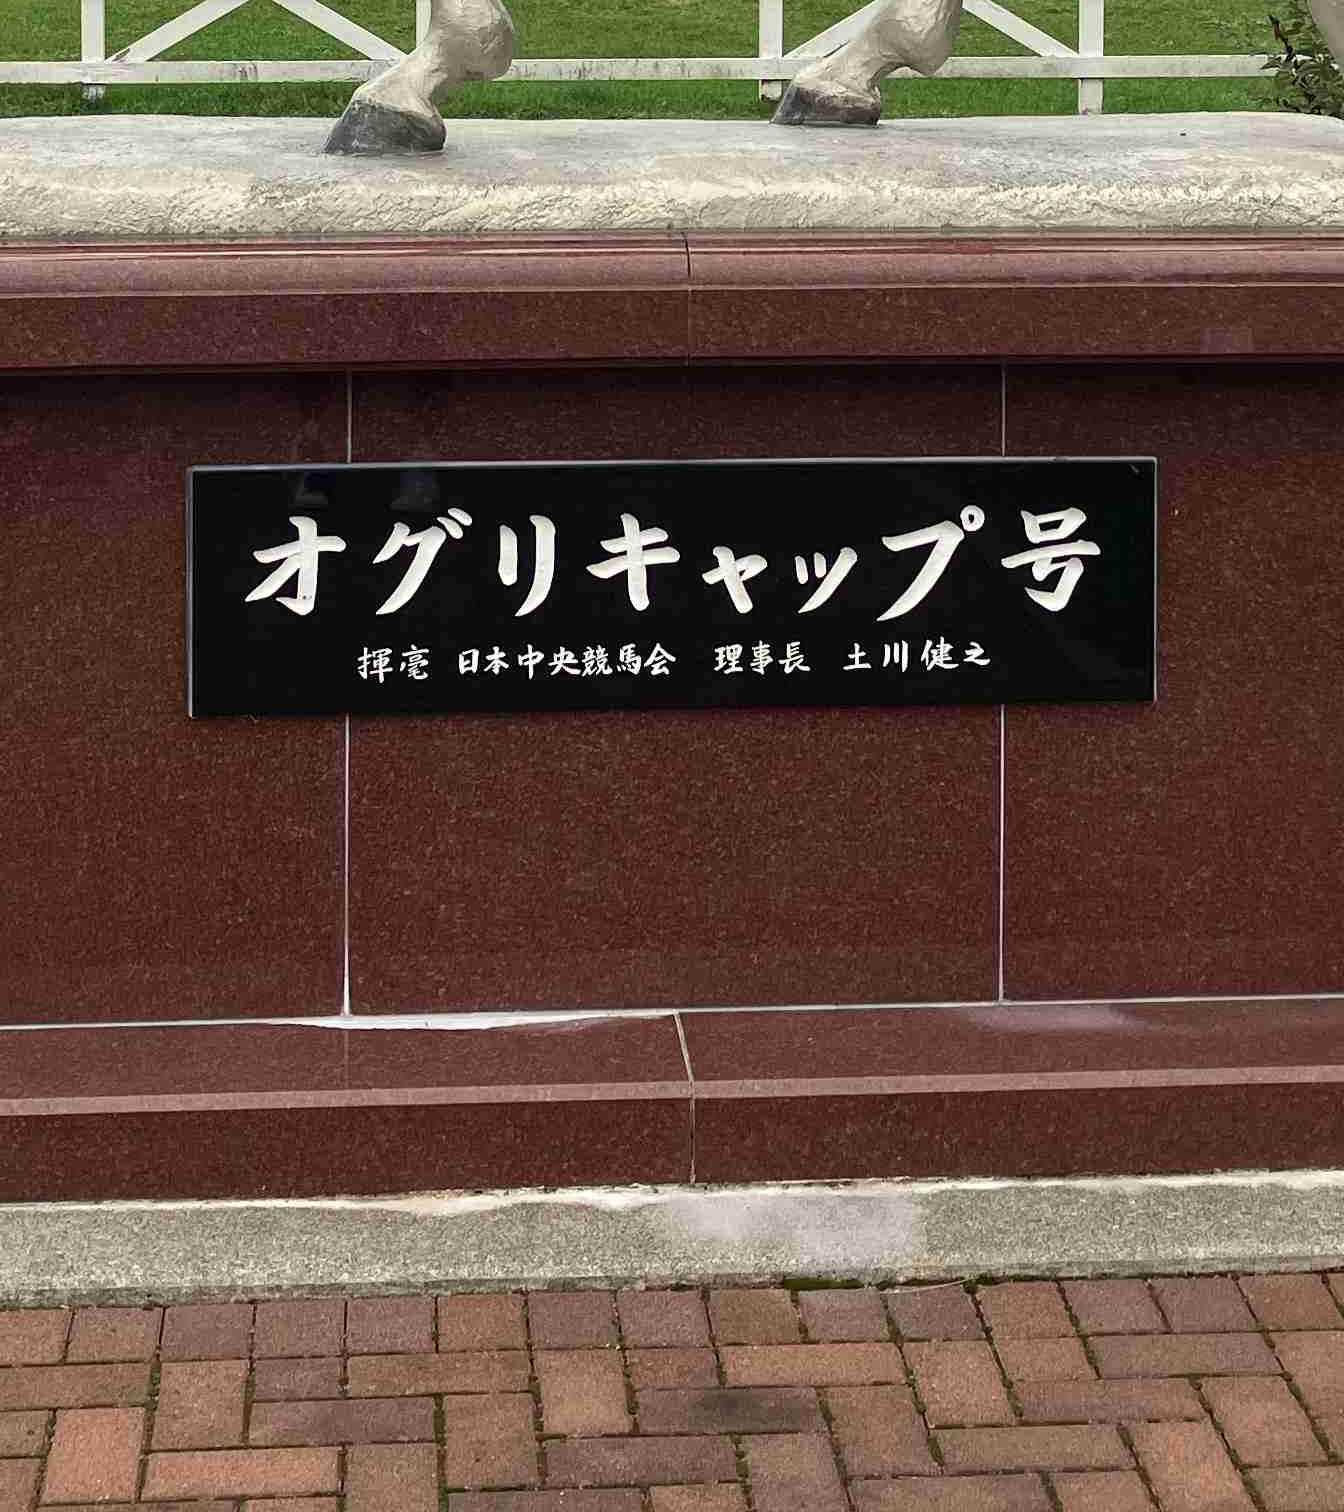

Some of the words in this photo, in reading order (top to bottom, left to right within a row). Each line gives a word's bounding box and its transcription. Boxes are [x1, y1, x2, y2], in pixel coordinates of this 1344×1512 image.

[245, 505, 1102, 622] オグリキャップ号
[458, 642, 676, 680] 日本中央競馬会
[713, 640, 811, 675] 理事長
[843, 636, 991, 672] 土川健之
